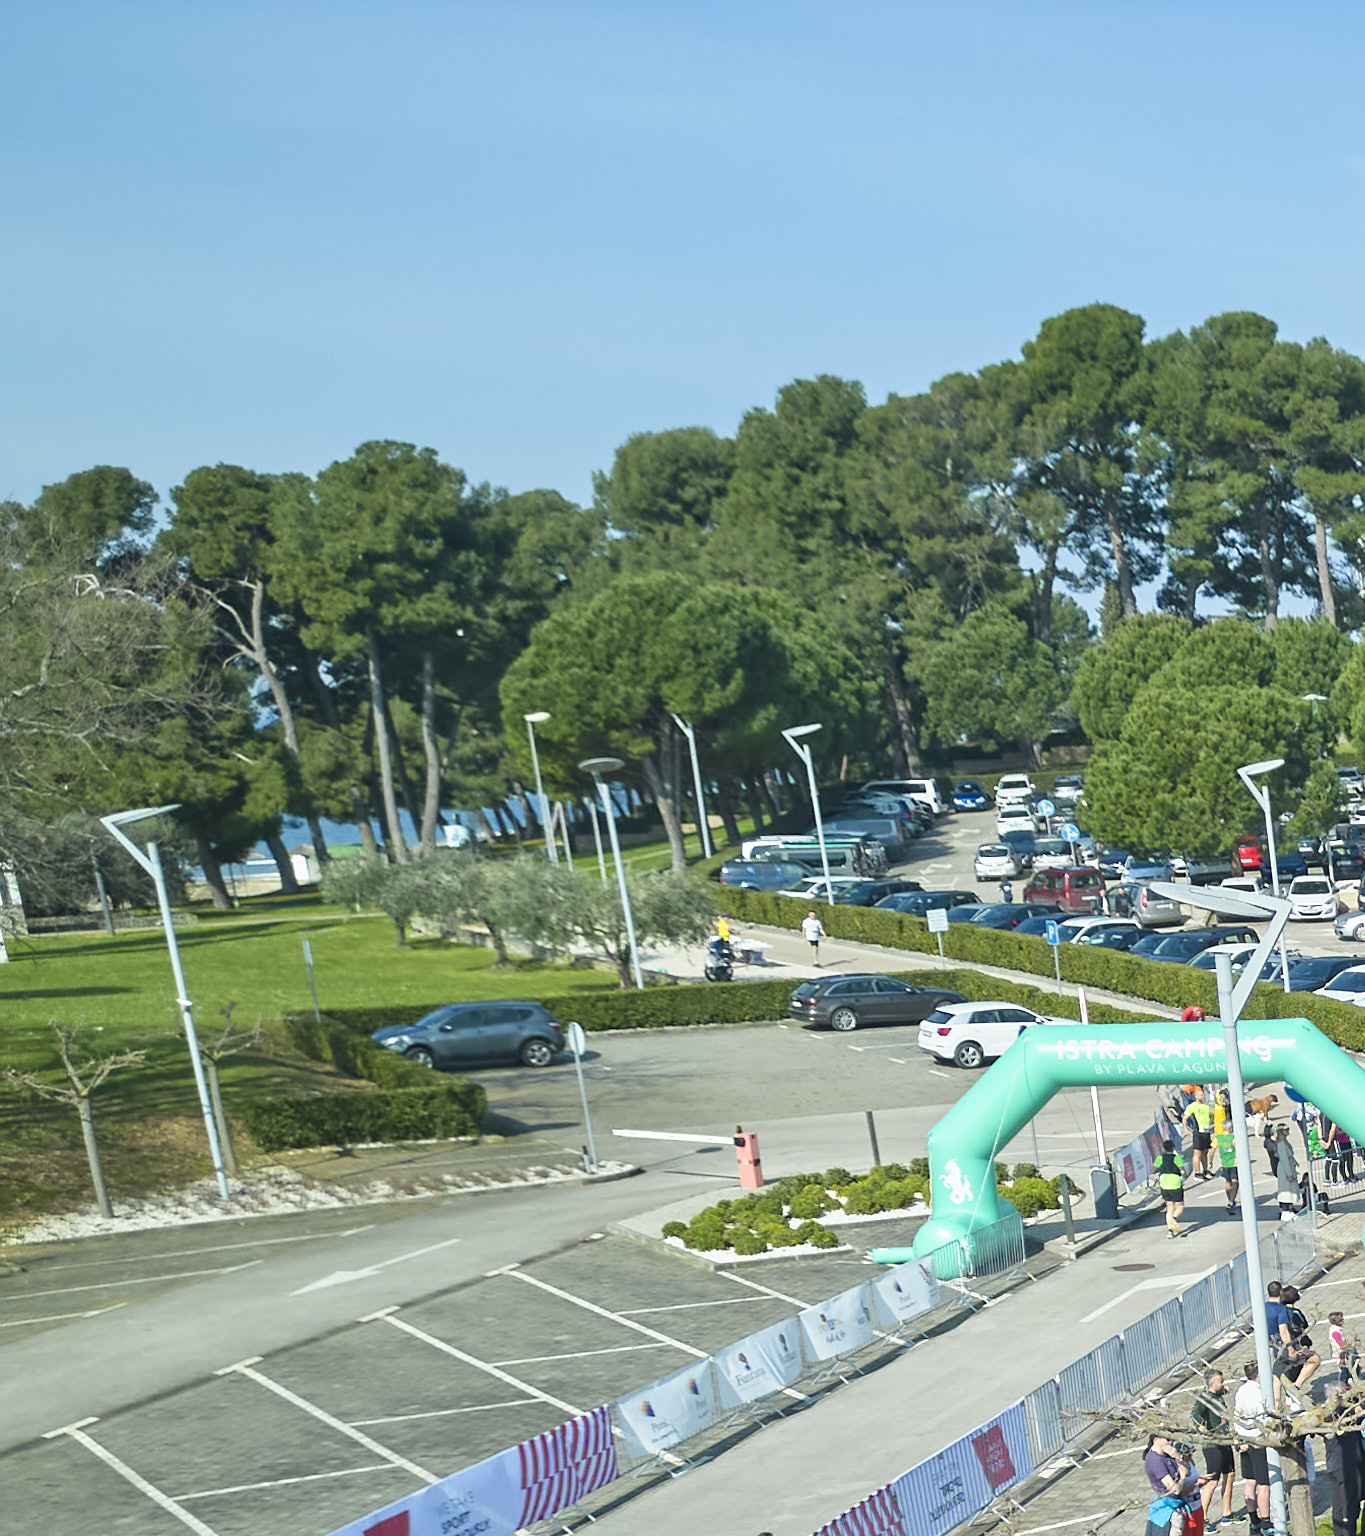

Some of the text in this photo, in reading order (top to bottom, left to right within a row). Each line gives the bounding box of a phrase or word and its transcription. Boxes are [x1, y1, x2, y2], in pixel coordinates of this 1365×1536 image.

[1056, 1035, 1272, 1062] ISTRA CAMPNG
[1094, 1062, 1227, 1075] BY PLAVA LAGUN
